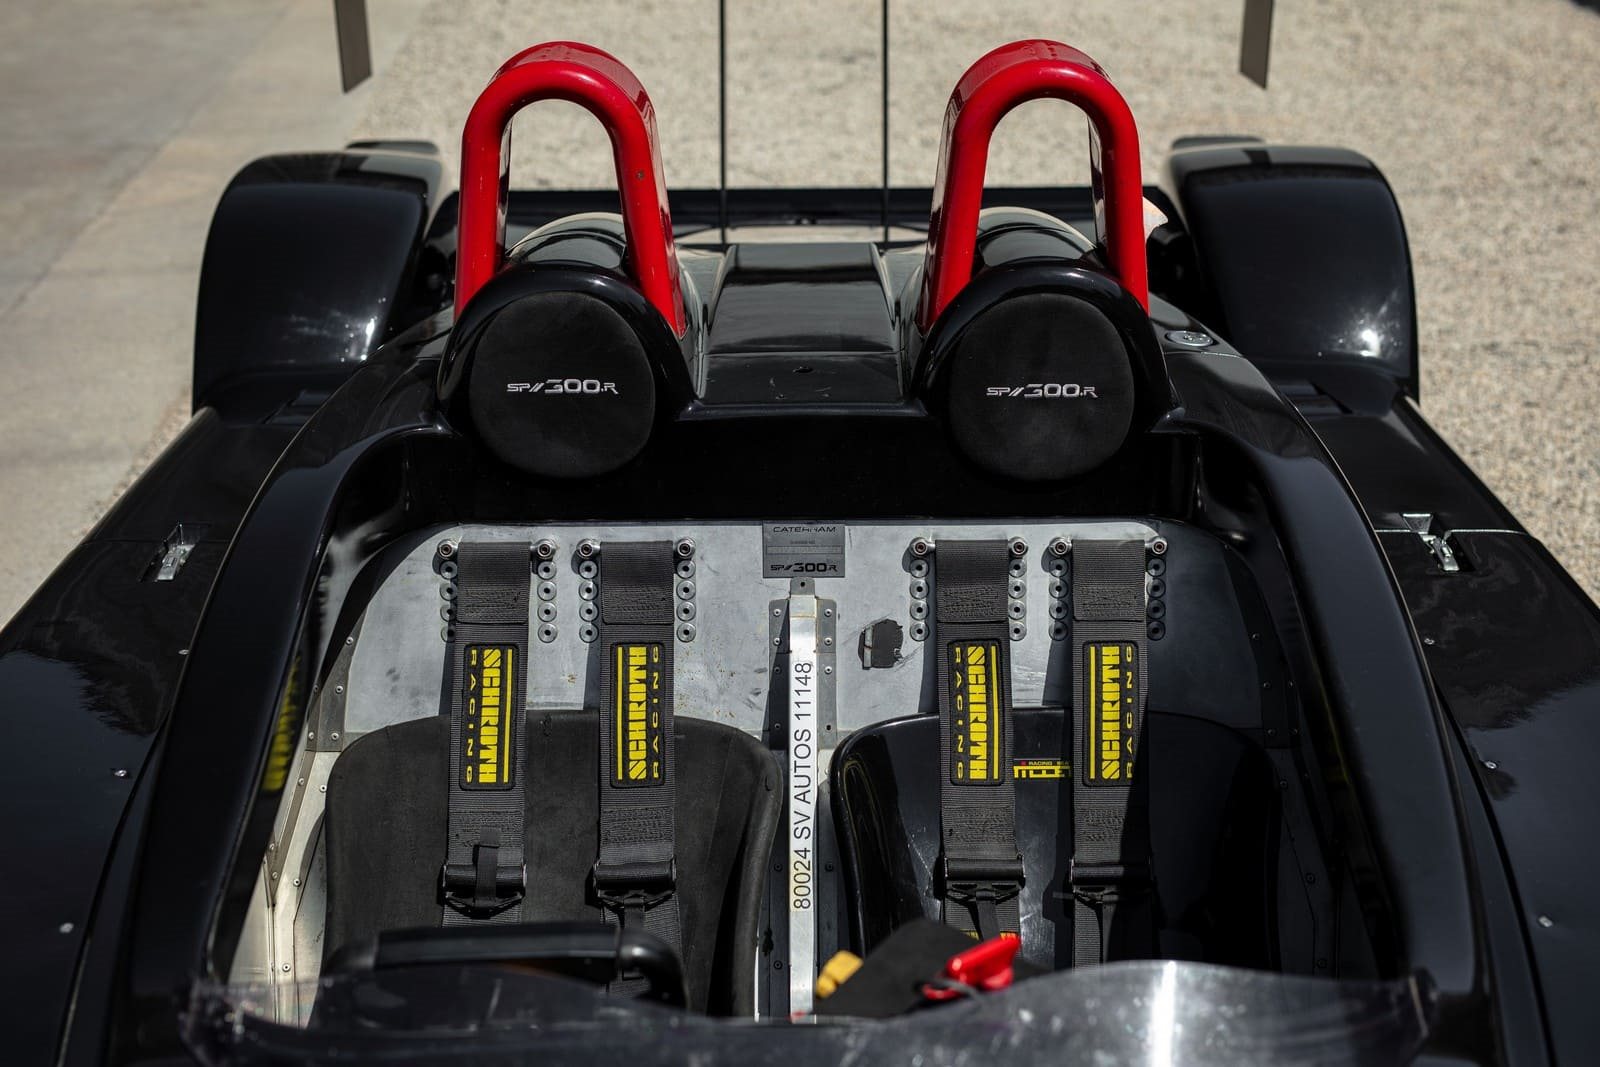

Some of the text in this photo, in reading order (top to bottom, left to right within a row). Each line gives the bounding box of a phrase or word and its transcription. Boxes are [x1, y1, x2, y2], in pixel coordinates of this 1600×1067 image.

[465, 649, 477, 783] RACING
[479, 648, 502, 784] SCHROTH
[628, 646, 647, 780] SCHROTH
[652, 646, 660, 779] RACING
[955, 646, 965, 780] RACING
[967, 646, 988, 780] SCHROTH
[1101, 645, 1121, 780] SCHROTH
[1125, 646, 1133, 779] RACING
[794, 662, 812, 910] 80024 SV AUTOS 11148
